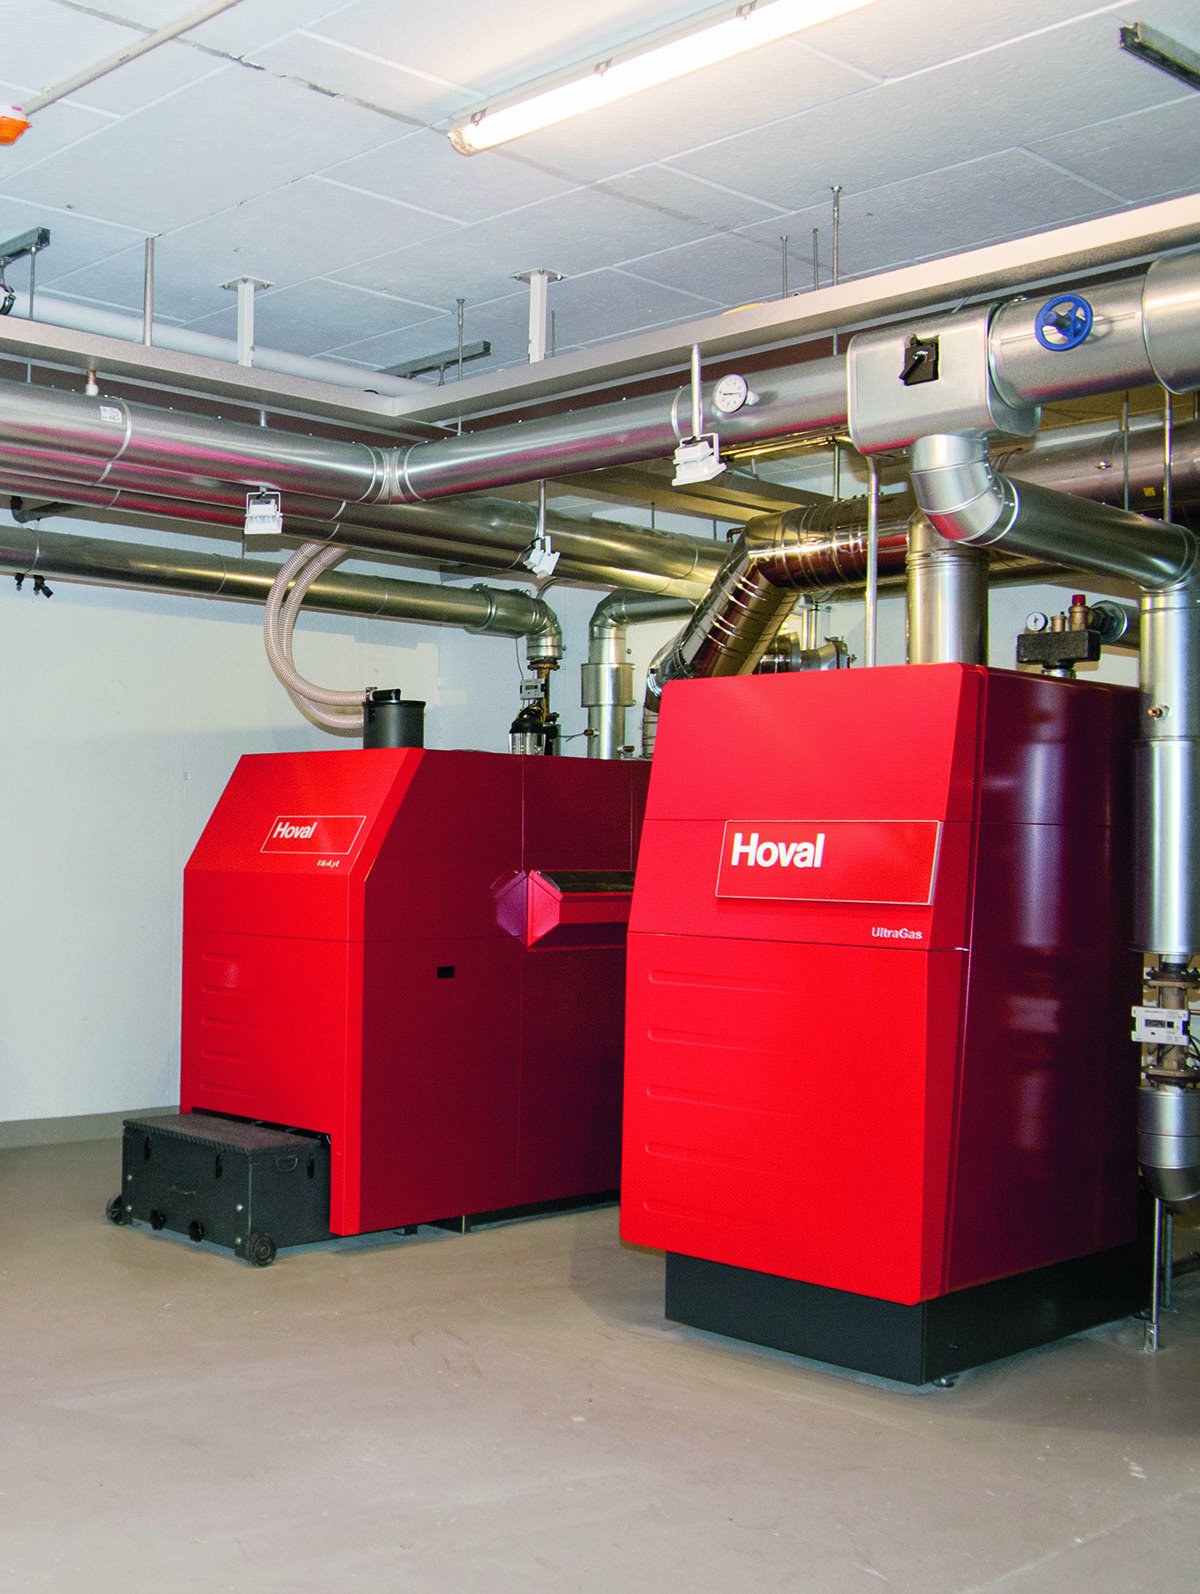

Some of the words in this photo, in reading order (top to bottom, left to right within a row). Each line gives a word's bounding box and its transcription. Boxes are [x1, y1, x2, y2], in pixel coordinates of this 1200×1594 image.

[272, 821, 318, 839] Hoval
[730, 832, 826, 868] Hoval
[871, 927, 923, 940] UltraGas
